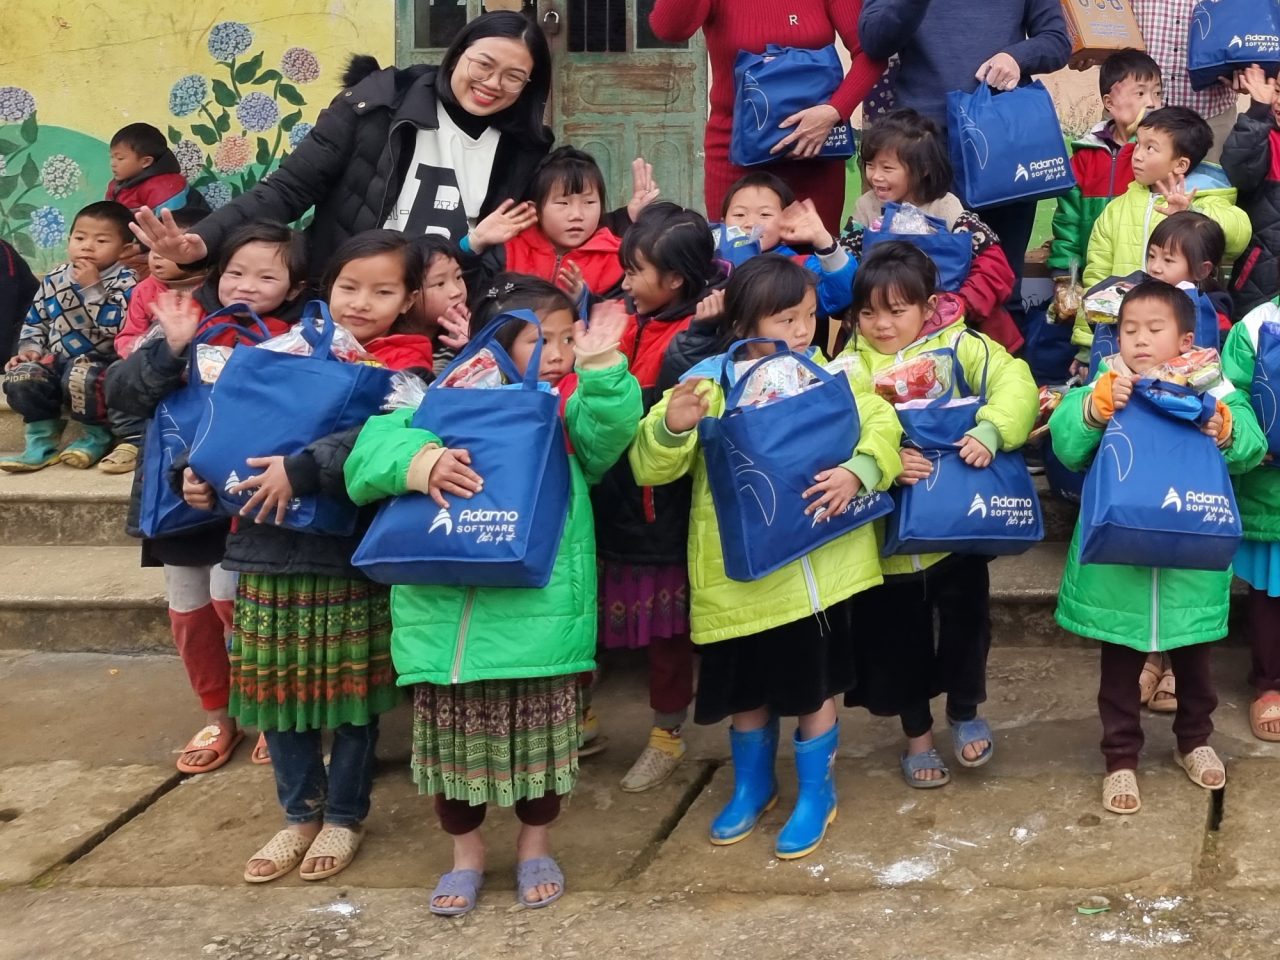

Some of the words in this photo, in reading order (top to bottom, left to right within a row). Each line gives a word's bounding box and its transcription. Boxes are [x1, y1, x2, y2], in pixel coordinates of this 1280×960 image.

[788, 14, 798, 26] R
[1244, 34, 1280, 42] Adamo
[1030, 156, 1064, 172] Adamo
[1031, 165, 1065, 178] SOFTWARE
[990, 496, 1032, 508] Adamo
[1186, 491, 1230, 508] Adamo
[458, 509, 518, 522] Adamo
[990, 509, 1033, 517] SOFTWARE
[456, 524, 516, 533] SOFTWARE
